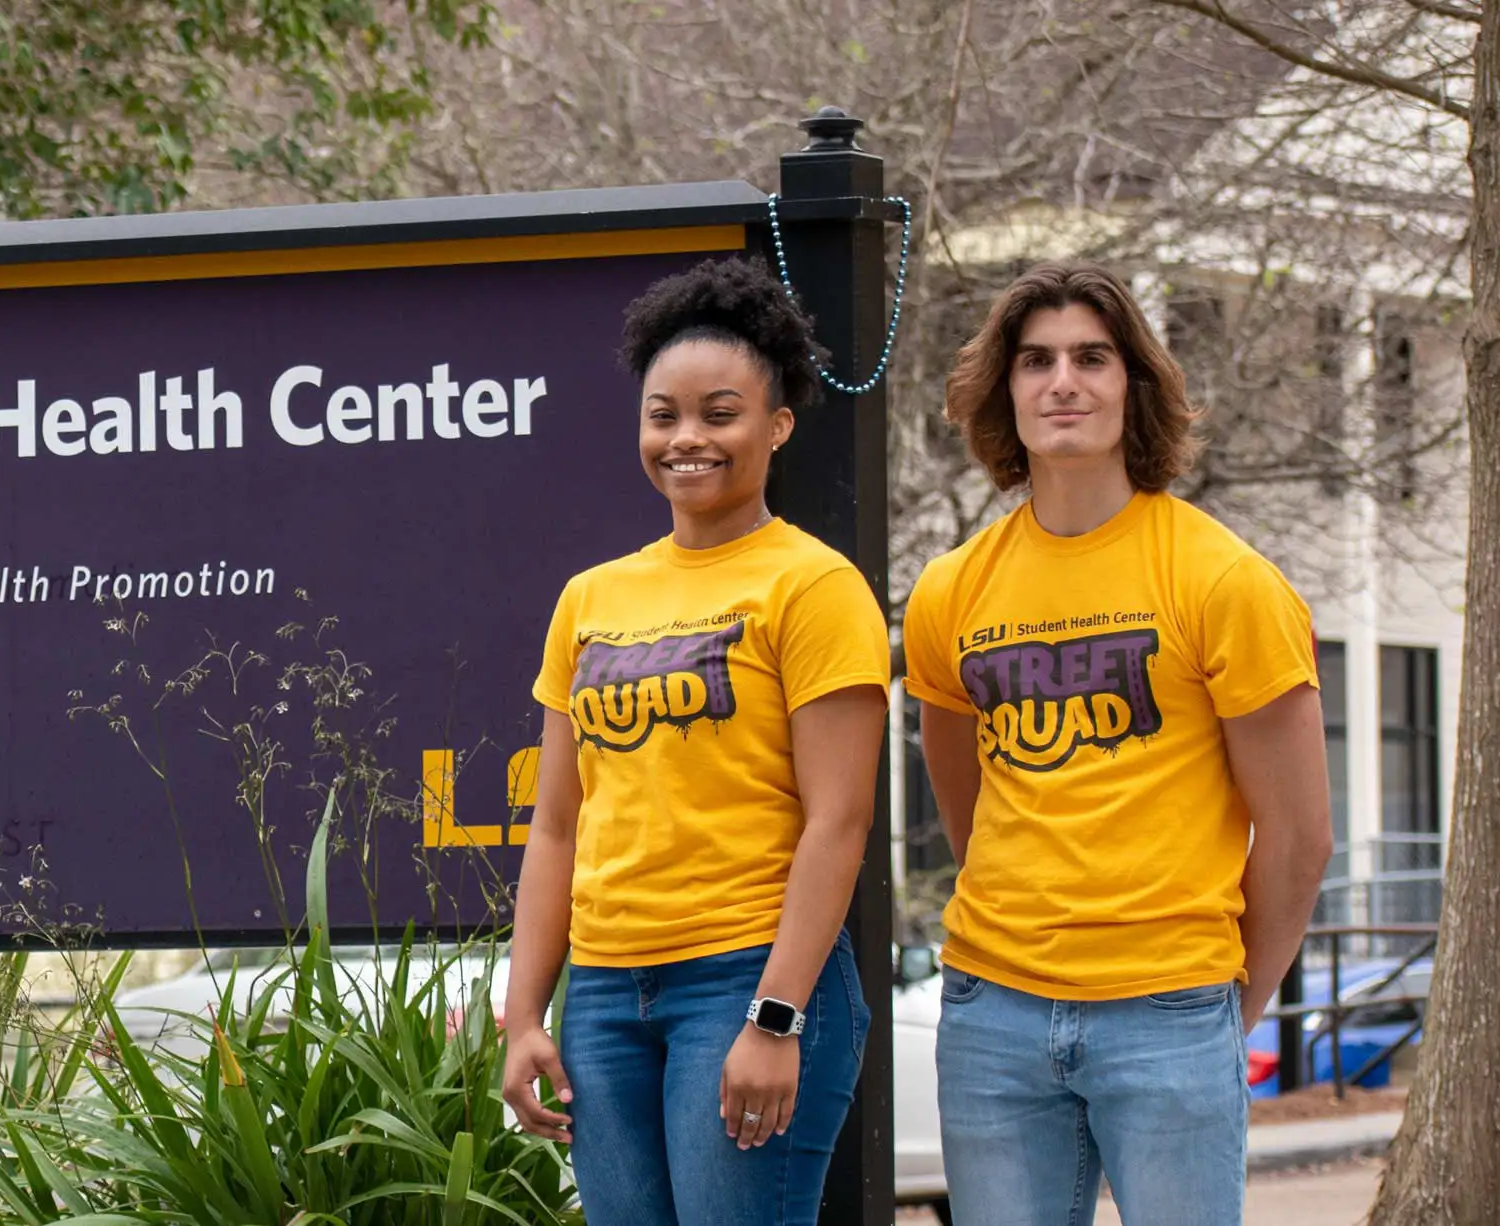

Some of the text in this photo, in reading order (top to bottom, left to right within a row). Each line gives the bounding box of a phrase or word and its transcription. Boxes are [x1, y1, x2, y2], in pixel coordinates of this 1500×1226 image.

[269, 362, 547, 446] Center
[69, 560, 275, 601] Promotion
[711, 611, 749, 625] Center
[958, 610, 1156, 653] LSU Student Health Center
[962, 635, 1155, 731] STREET
[2, 819, 56, 858] ST
